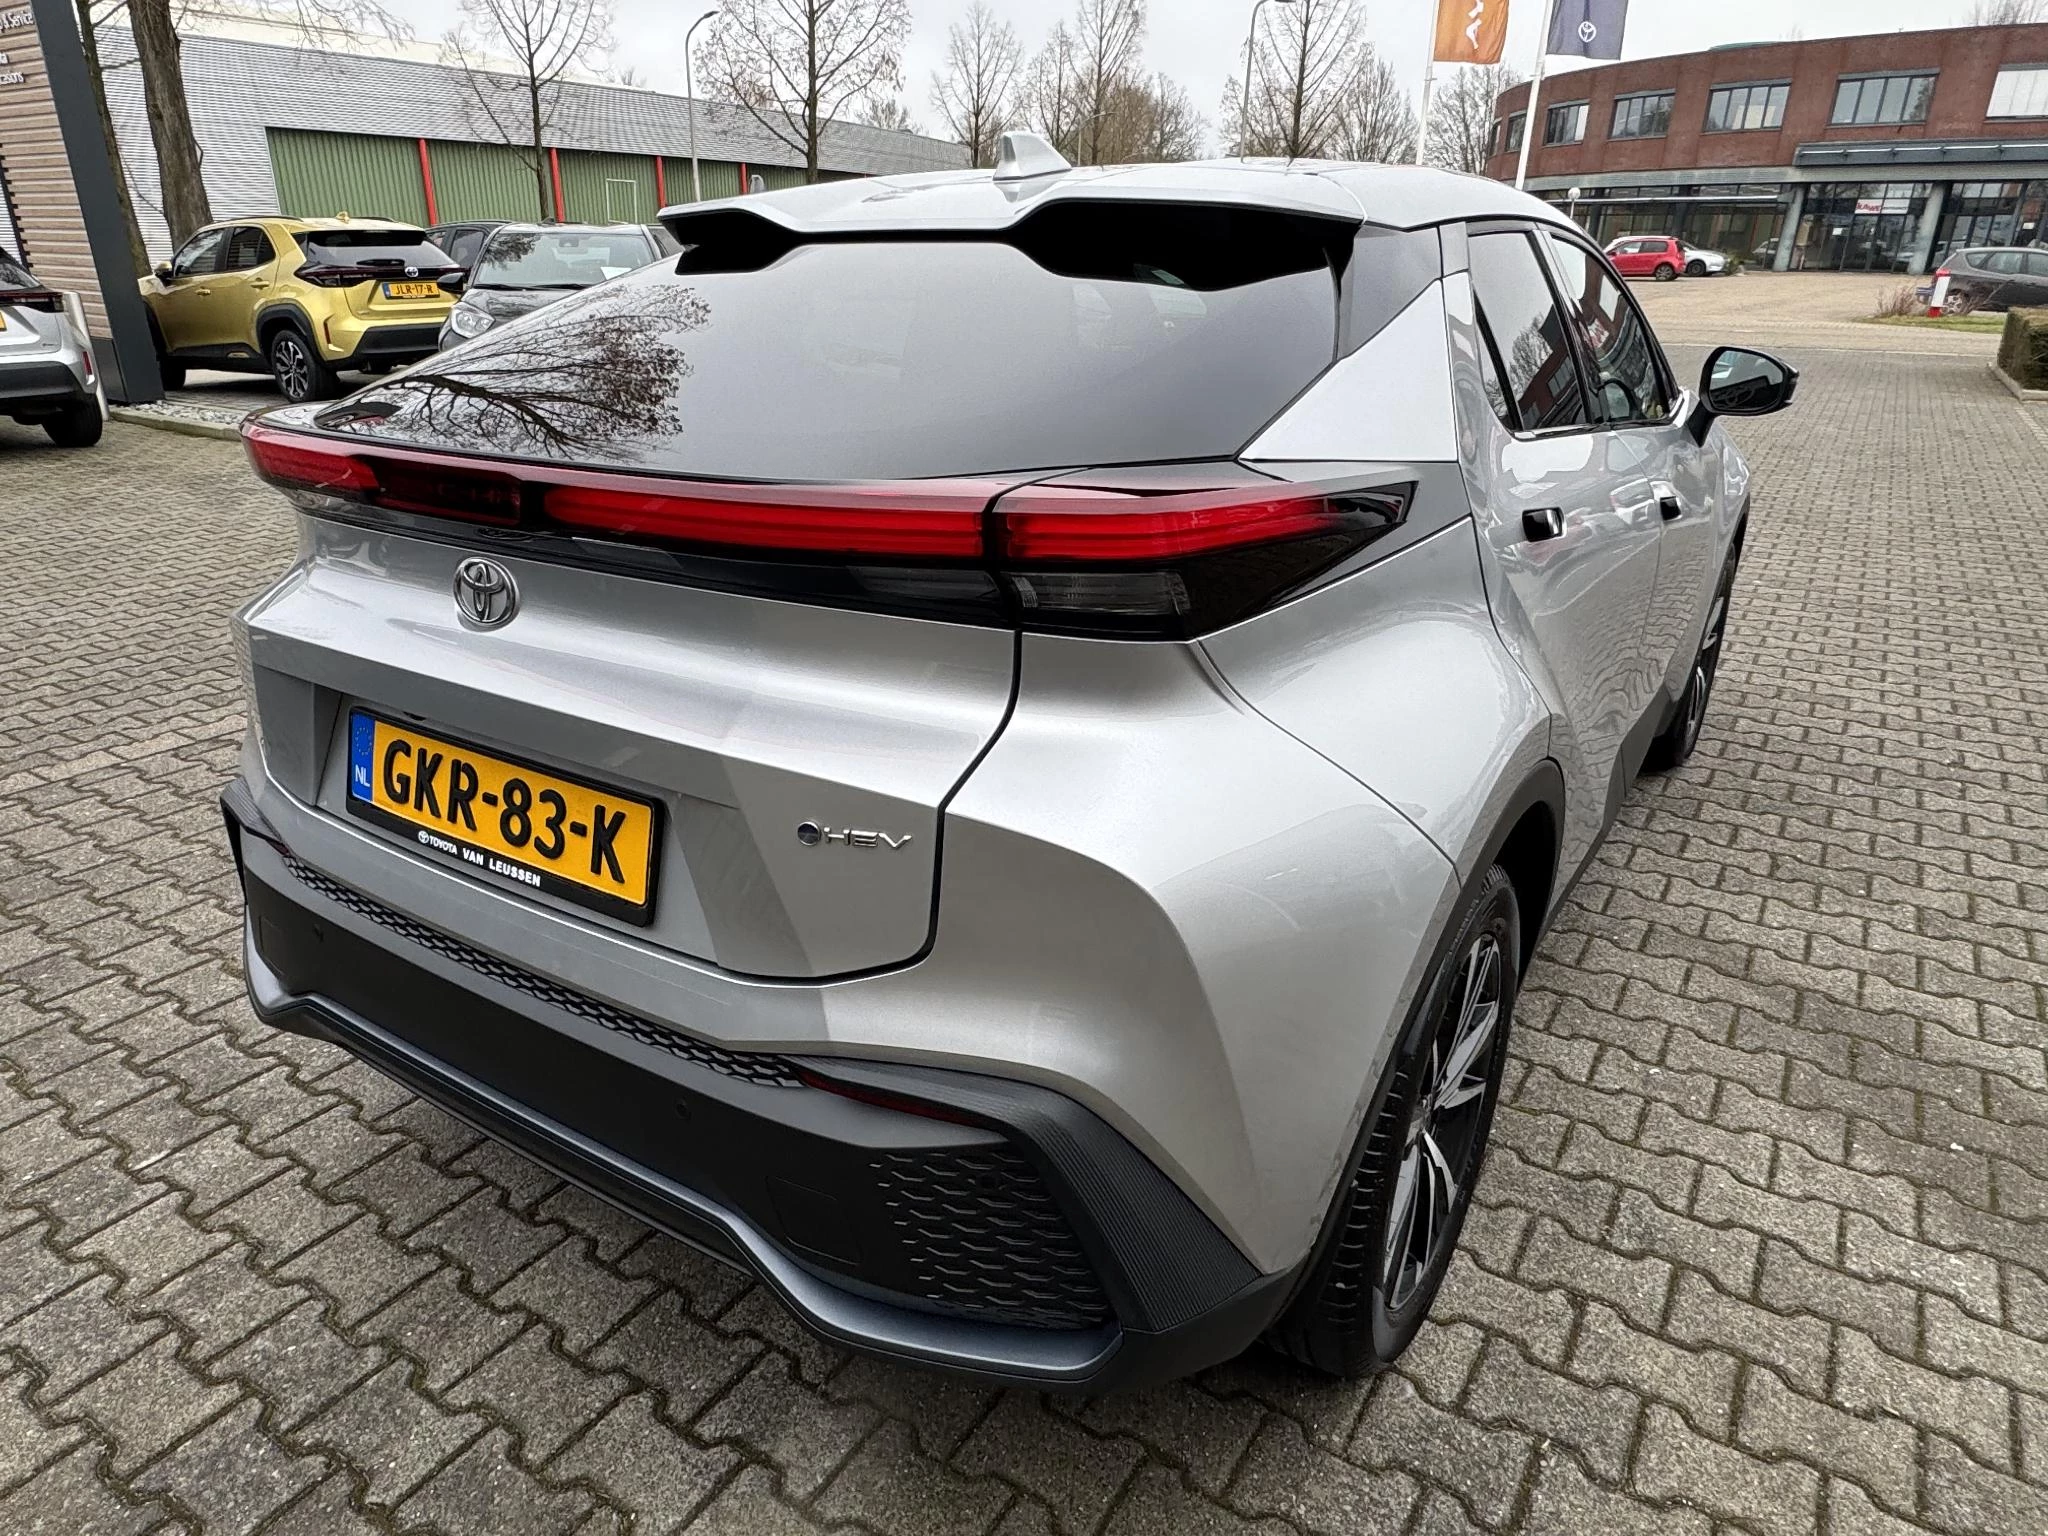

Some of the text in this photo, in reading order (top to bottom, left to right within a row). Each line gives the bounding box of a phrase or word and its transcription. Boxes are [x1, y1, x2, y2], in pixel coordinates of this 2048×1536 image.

[396, 284, 434, 295] JLR-17-R
[354, 764, 371, 788] NL
[382, 738, 627, 884] GKR-83-K
[823, 826, 913, 849] HEV
[429, 835, 541, 887] TOYOTA VAN LEUSSEN
